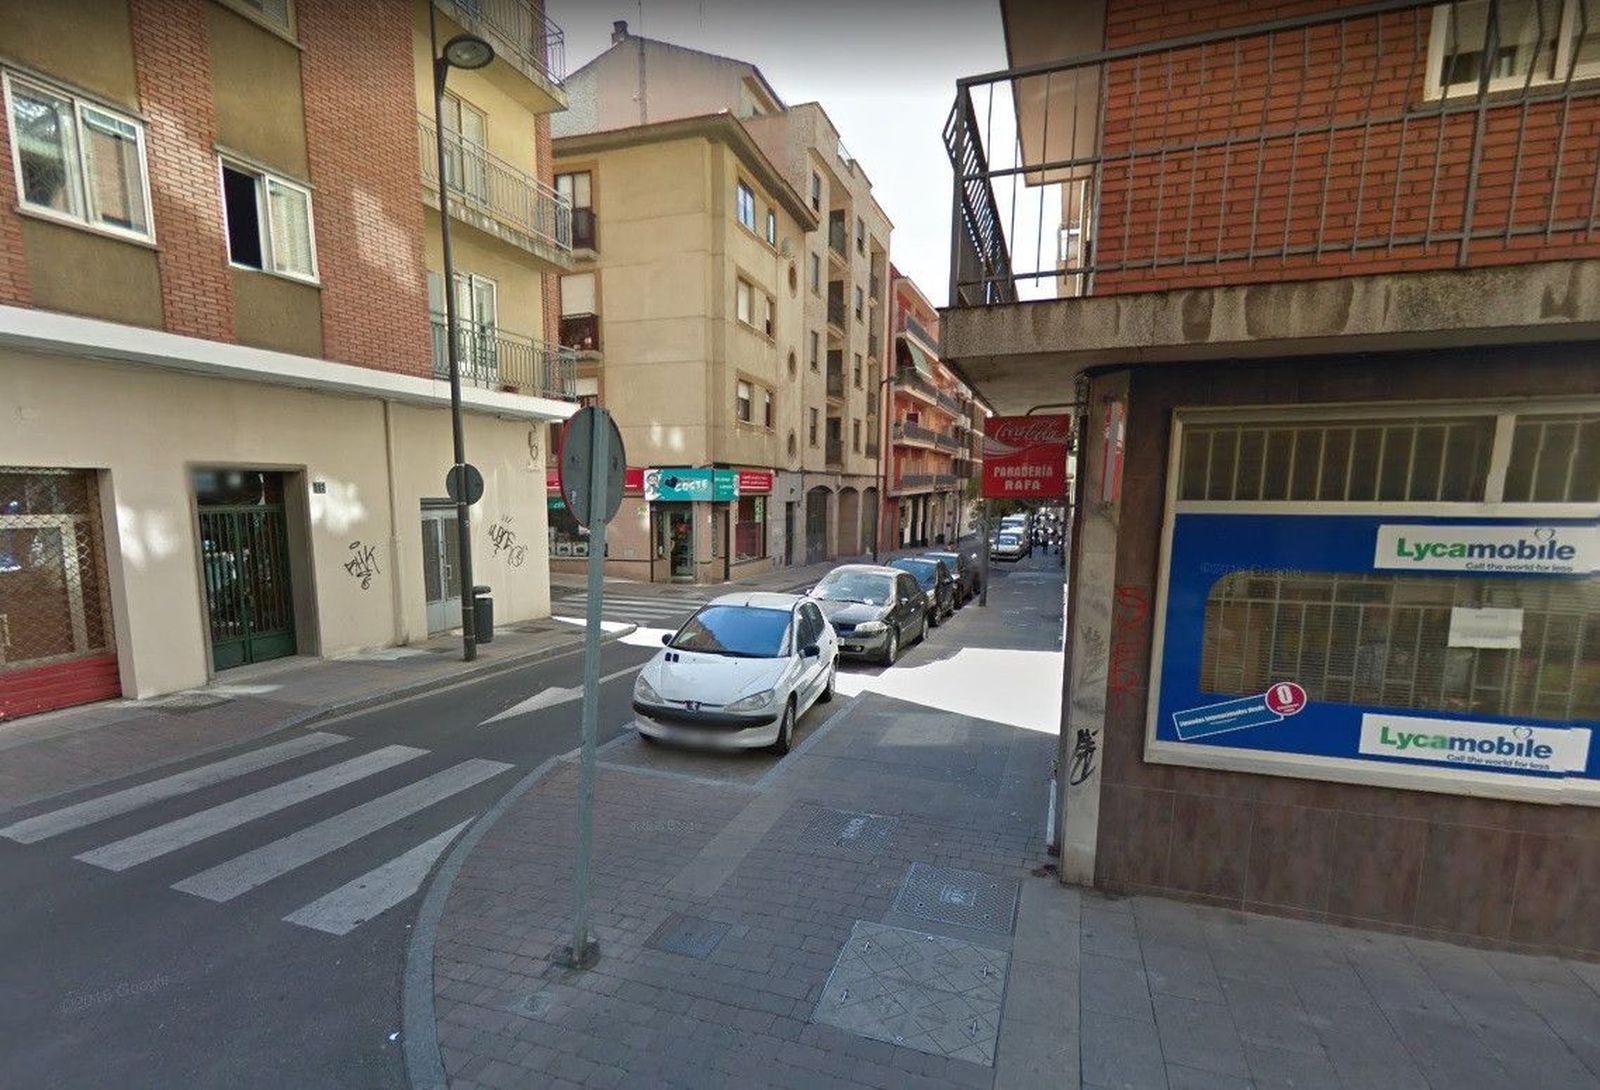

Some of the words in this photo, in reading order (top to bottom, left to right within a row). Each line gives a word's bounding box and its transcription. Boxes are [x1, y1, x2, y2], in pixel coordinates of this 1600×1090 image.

[1005, 480, 1041, 490] RAFA
[1397, 537, 1576, 561] Lycamobile
[1380, 726, 1553, 759] Lycamobile
